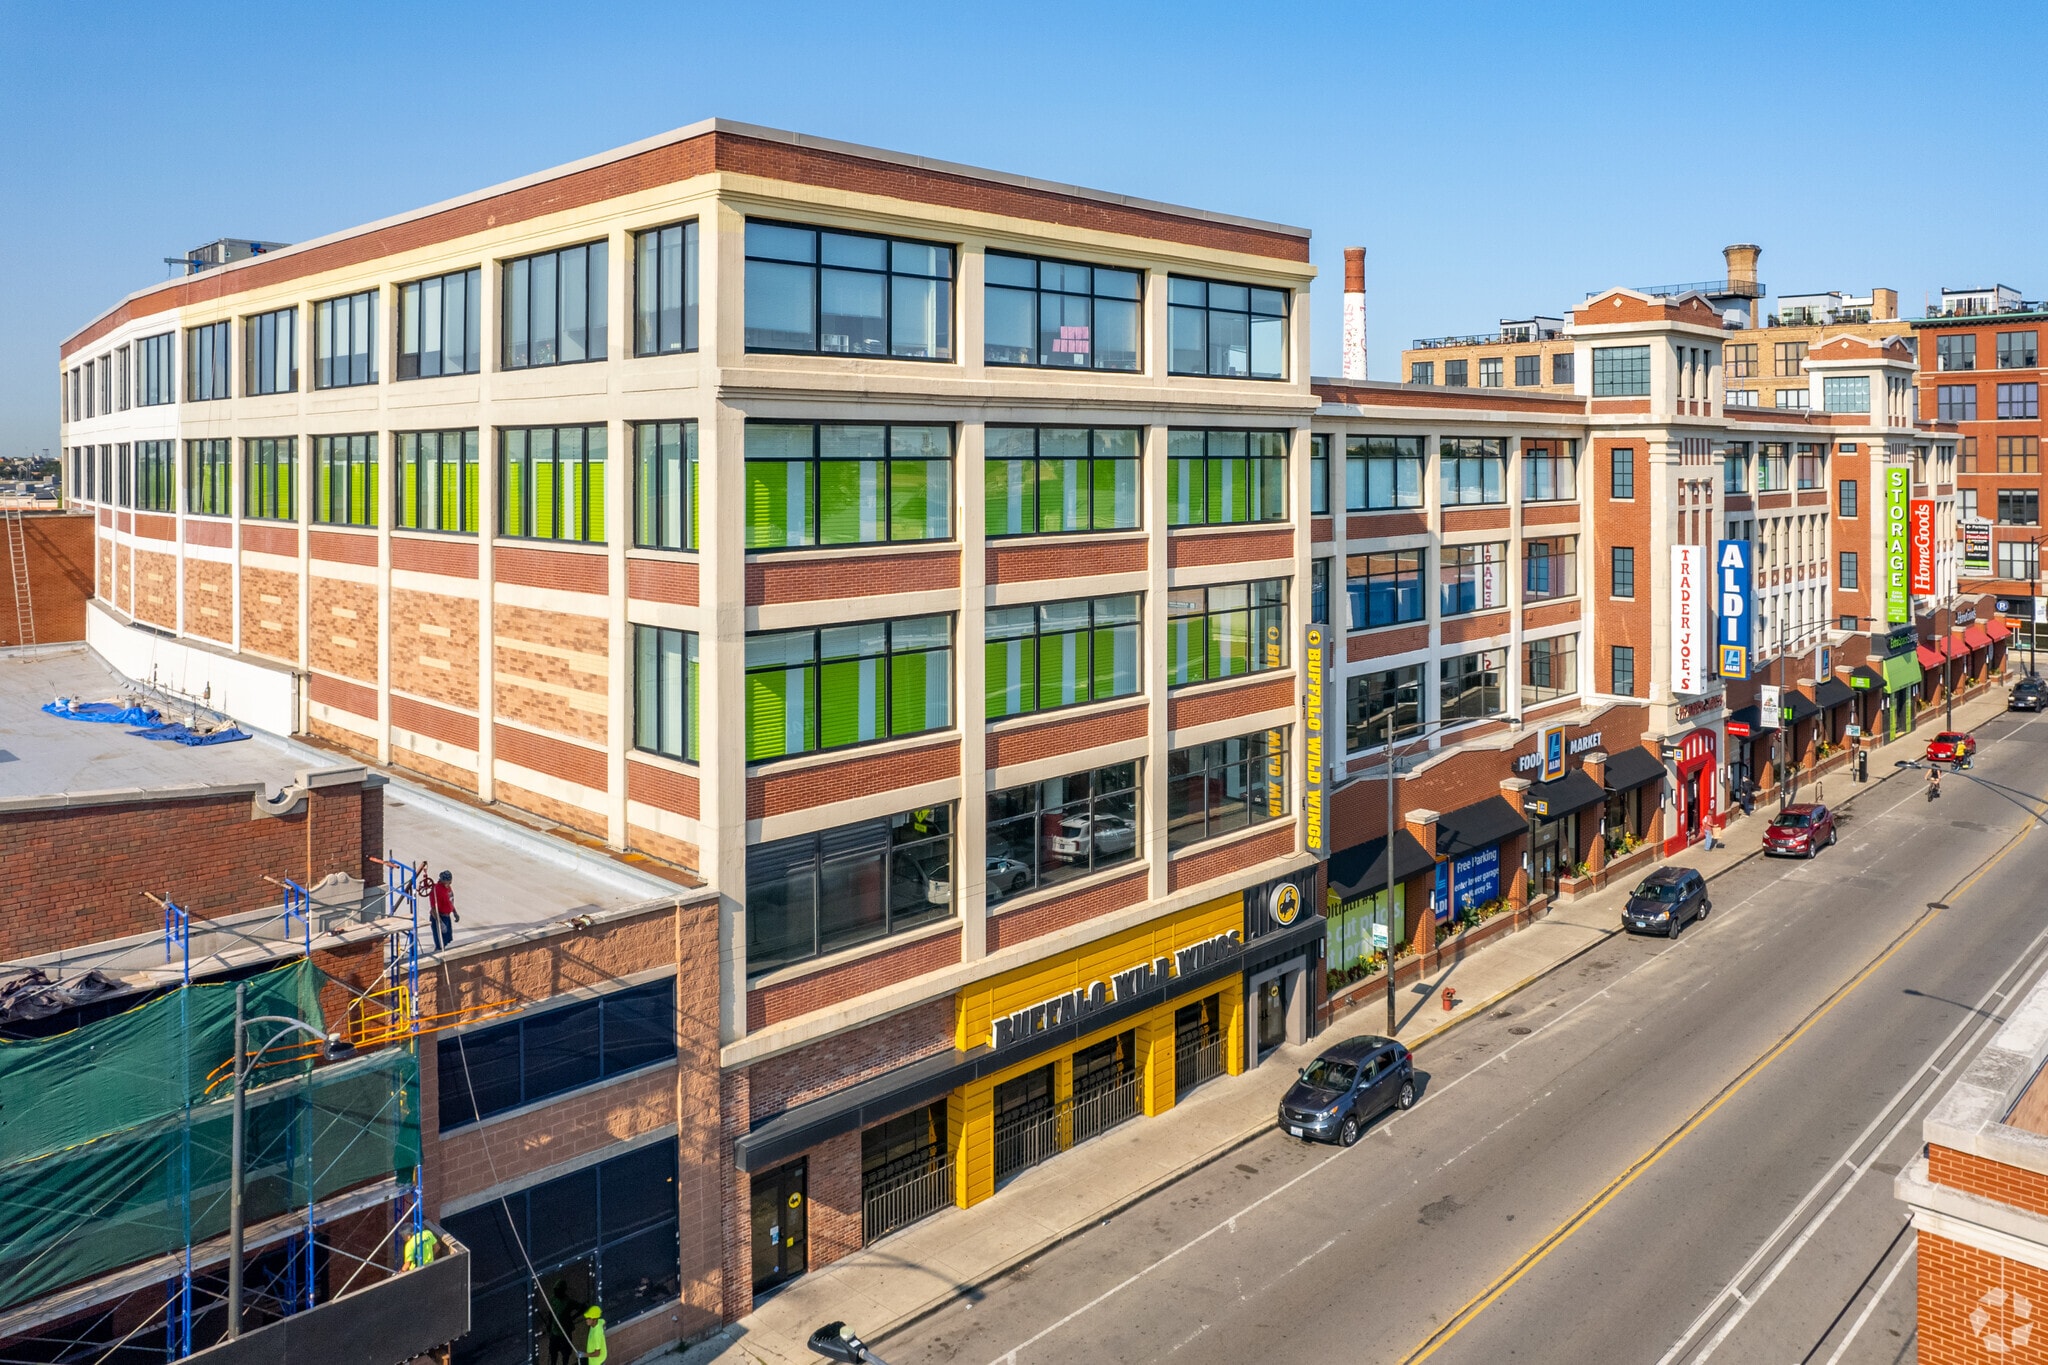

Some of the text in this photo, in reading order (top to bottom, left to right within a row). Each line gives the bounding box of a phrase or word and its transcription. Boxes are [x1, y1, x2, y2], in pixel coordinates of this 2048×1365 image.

[1890, 472, 1904, 587] STORAGE
[1914, 503, 1930, 591] HomeGoods
[1680, 549, 1691, 690] TRADER JOE'S
[1721, 544, 1744, 642] ALDI
[1724, 664, 1740, 672] ALDI
[1307, 648, 1321, 849] BUFFALO WILD WINGS
[1519, 732, 1602, 771] FOOD MARKET
[1548, 758, 1560, 771] ALDI
[1457, 860, 1471, 873] Free
[1483, 867, 1499, 882] garage
[1435, 899, 1448, 915] LDI
[992, 929, 1242, 1049] BUFFALO WILD WINGS
